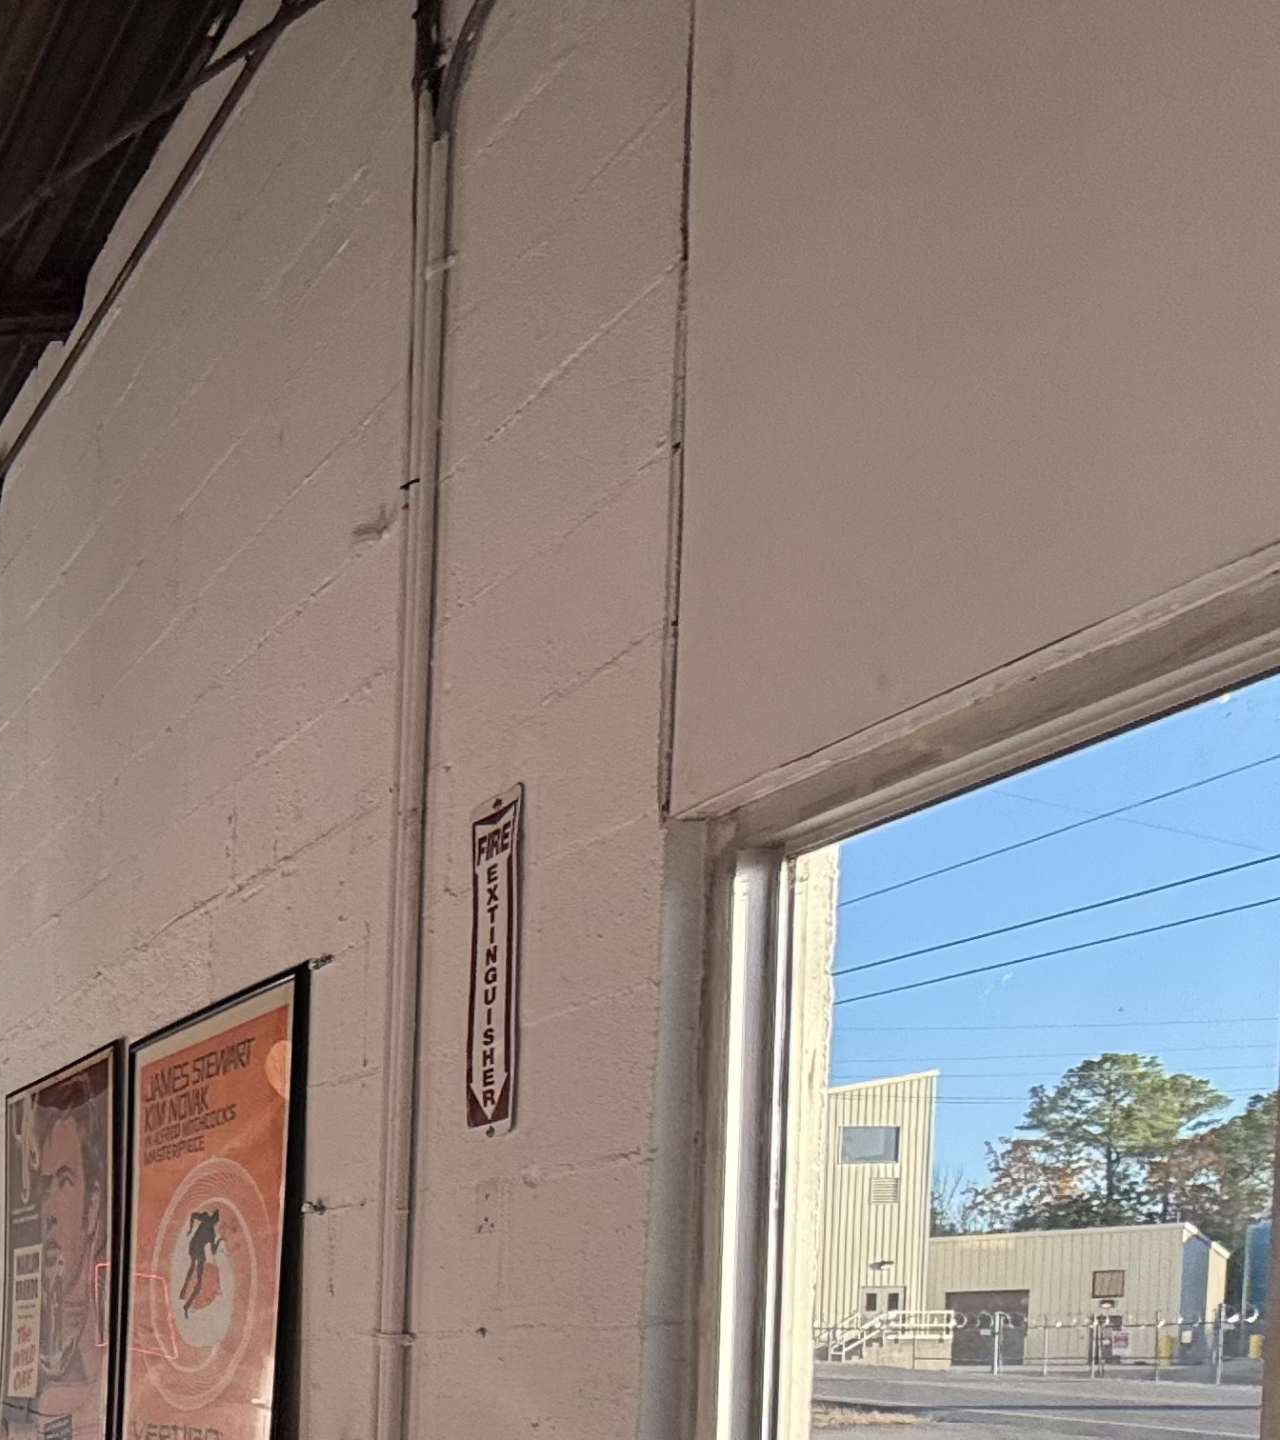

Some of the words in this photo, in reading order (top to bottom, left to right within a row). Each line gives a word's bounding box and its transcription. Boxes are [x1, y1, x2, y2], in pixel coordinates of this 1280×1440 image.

[477, 820, 512, 867] FIRE
[481, 863, 499, 1107] EXTINGUISHER
[145, 1062, 190, 1103] JAMES
[192, 1038, 256, 1085] STEWART
[144, 1100, 166, 1133] KIM
[167, 1086, 209, 1125] NOVAK
